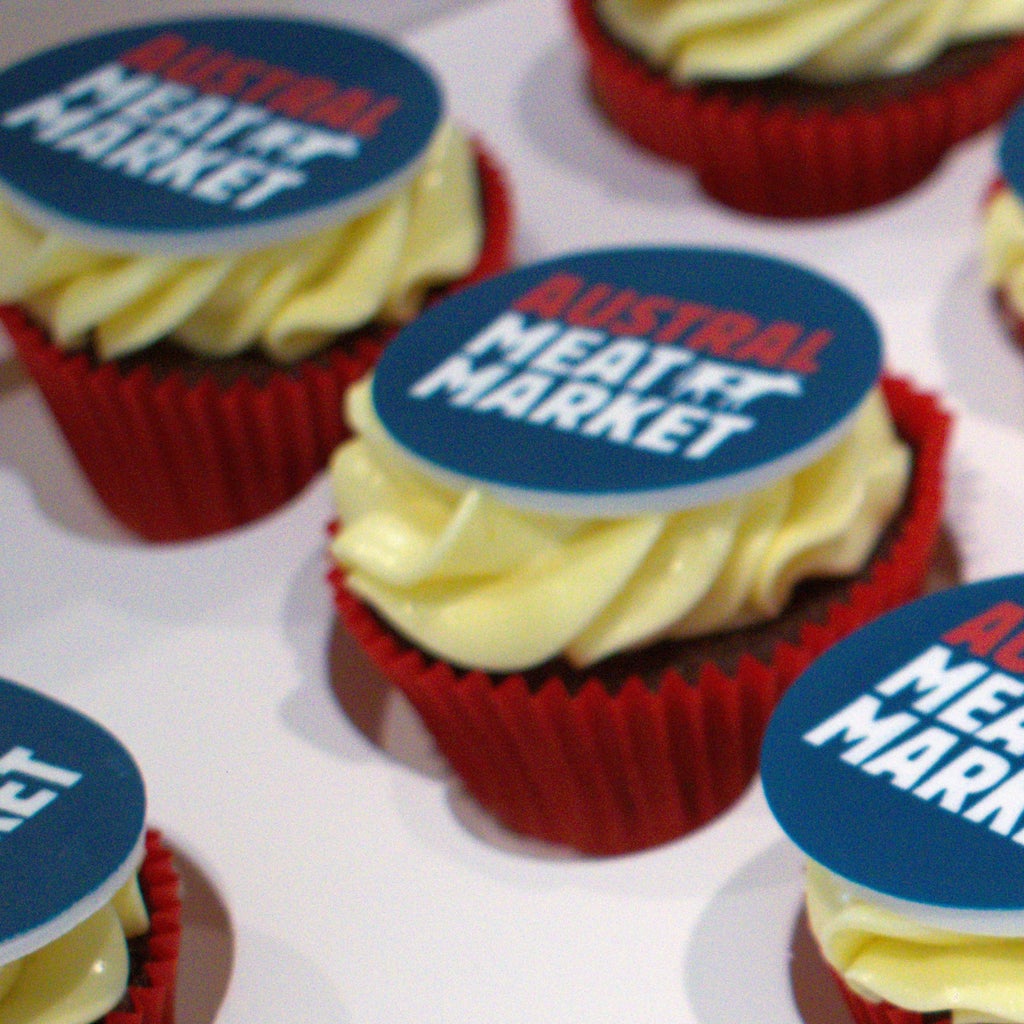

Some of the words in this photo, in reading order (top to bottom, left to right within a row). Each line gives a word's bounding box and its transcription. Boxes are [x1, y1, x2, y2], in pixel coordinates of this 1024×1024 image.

[466, 311, 695, 394] MEAT
[511, 273, 835, 374] AUSTRAL
[408, 356, 756, 460] MARKET
